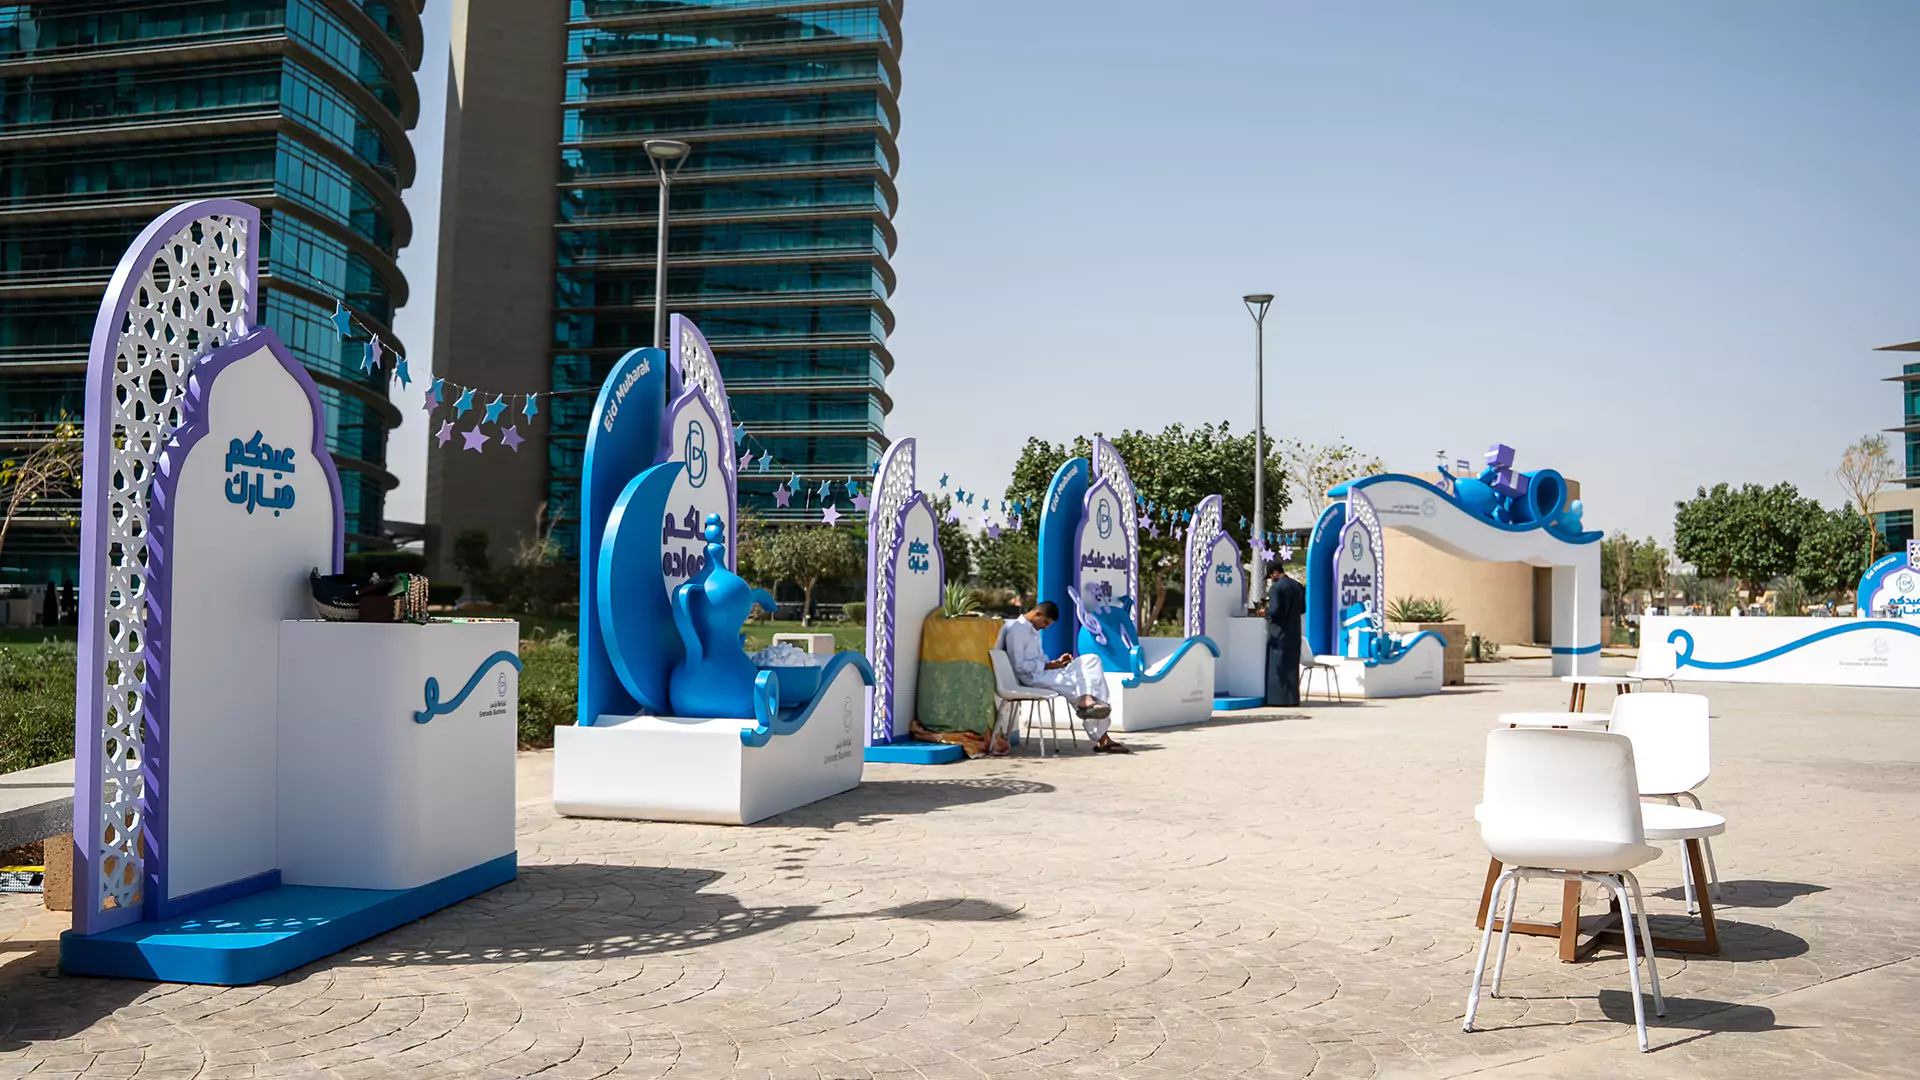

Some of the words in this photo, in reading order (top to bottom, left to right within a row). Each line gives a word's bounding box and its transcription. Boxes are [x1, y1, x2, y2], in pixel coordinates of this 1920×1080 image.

[603, 402, 618, 432] Eid
[615, 358, 650, 405] Mubarak
[225, 430, 295, 480] عيدكم
[225, 471, 295, 518] مبارك
[1080, 549, 1106, 572] عليكم
[1865, 570, 1876, 580] Eid
